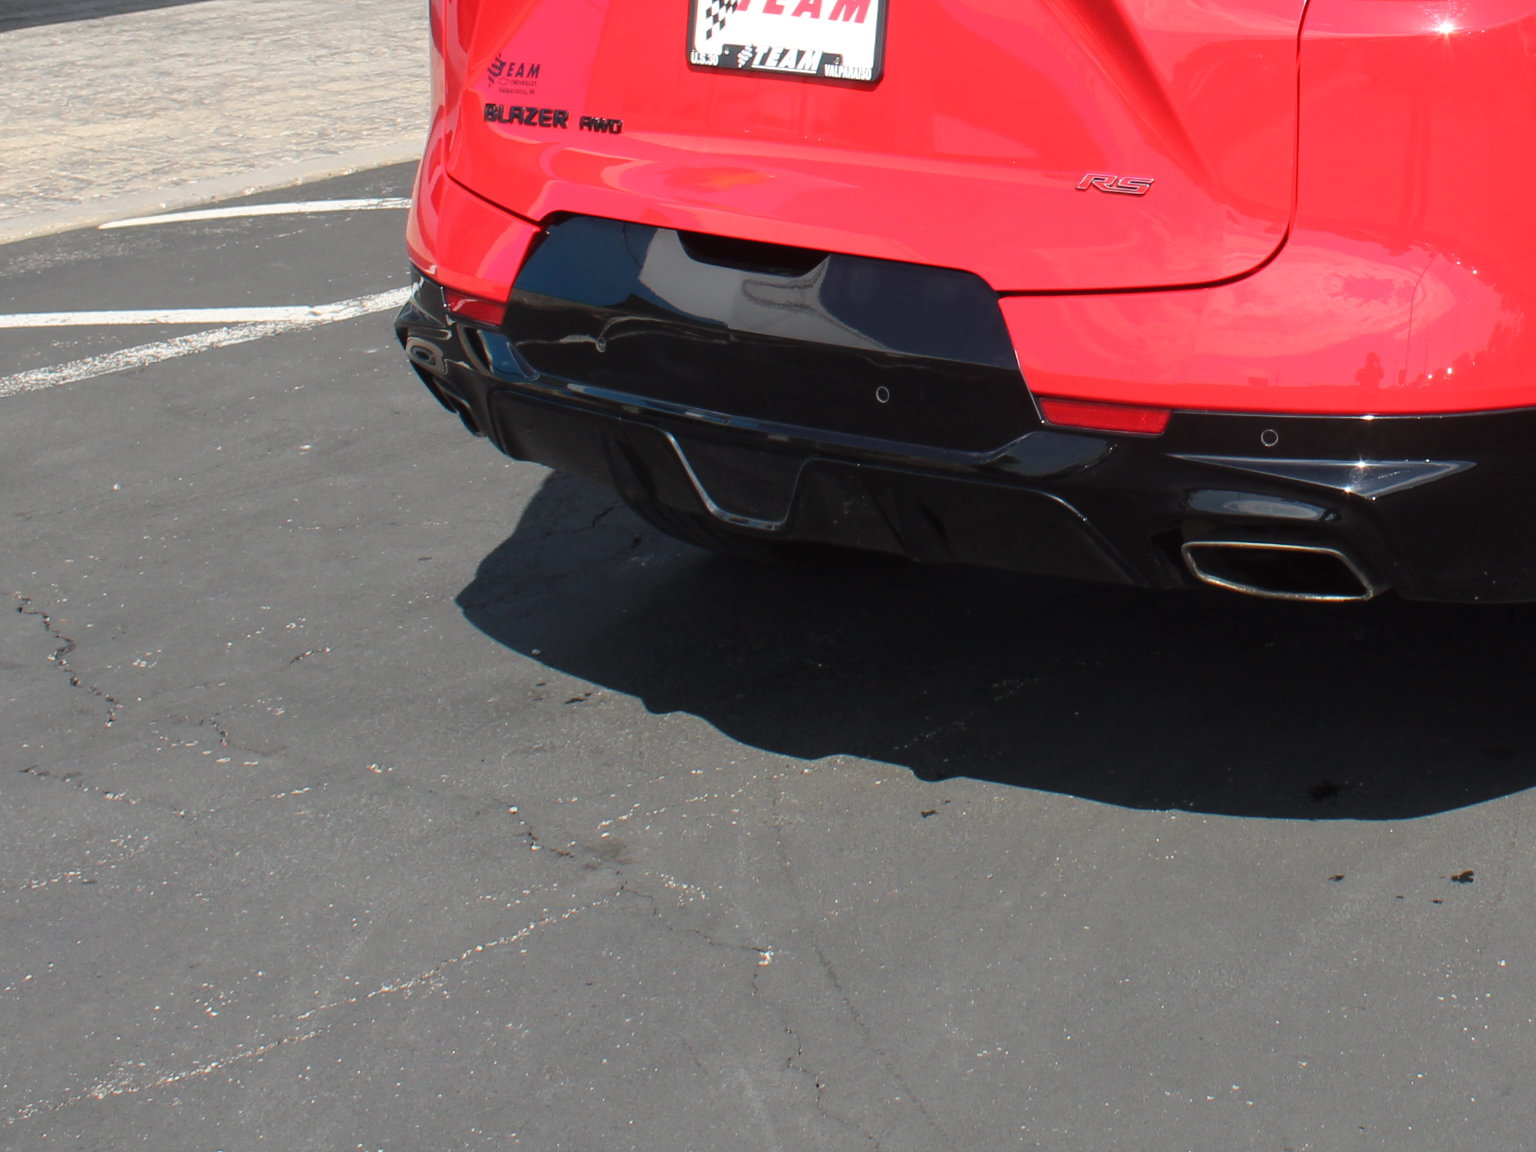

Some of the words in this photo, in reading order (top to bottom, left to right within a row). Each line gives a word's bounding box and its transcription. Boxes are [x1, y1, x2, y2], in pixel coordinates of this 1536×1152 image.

[752, 45, 823, 71] TEAM
[824, 63, 872, 81] VALPARAISO
[484, 103, 569, 129] BLAZER
[579, 116, 624, 134] AWD
[1075, 173, 1155, 196] RS
